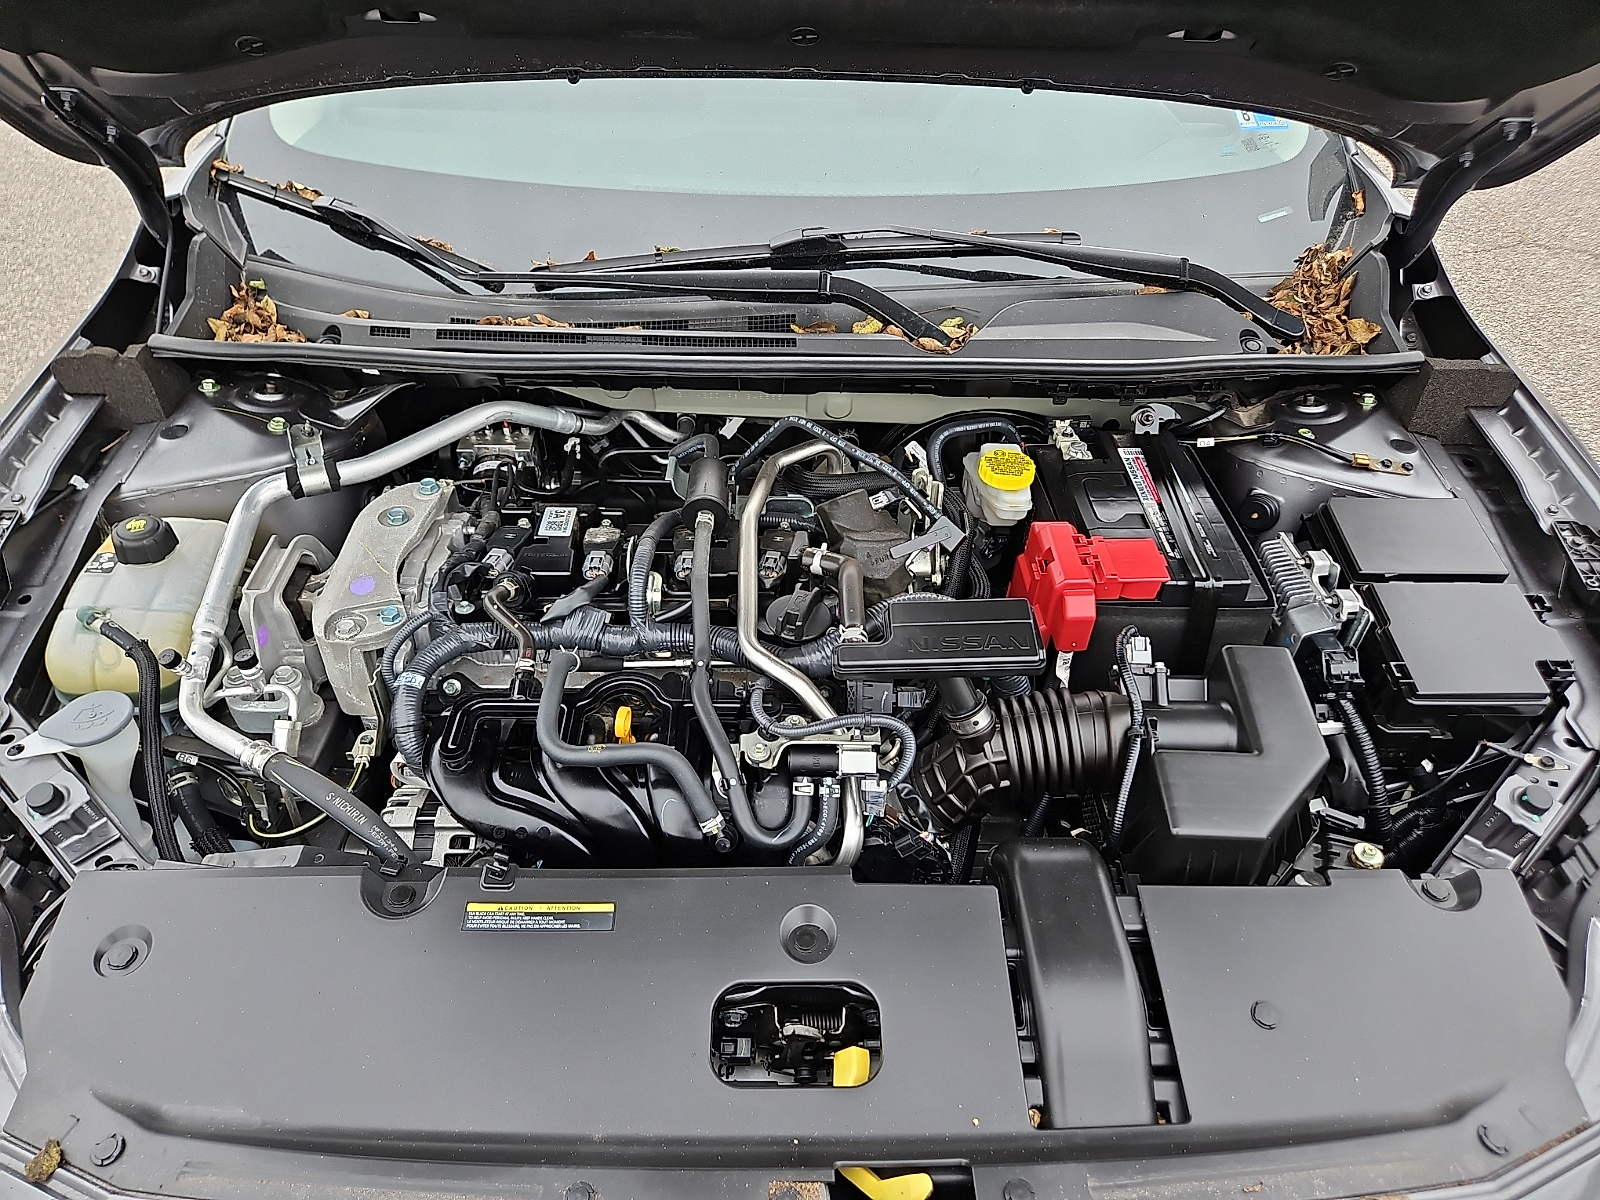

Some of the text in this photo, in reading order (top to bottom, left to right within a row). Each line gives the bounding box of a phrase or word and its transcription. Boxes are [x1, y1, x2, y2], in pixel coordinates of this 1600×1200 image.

[1124, 457, 1140, 481] NISSAN
[907, 634, 1031, 653] NISSAN
[178, 753, 193, 764] B6
